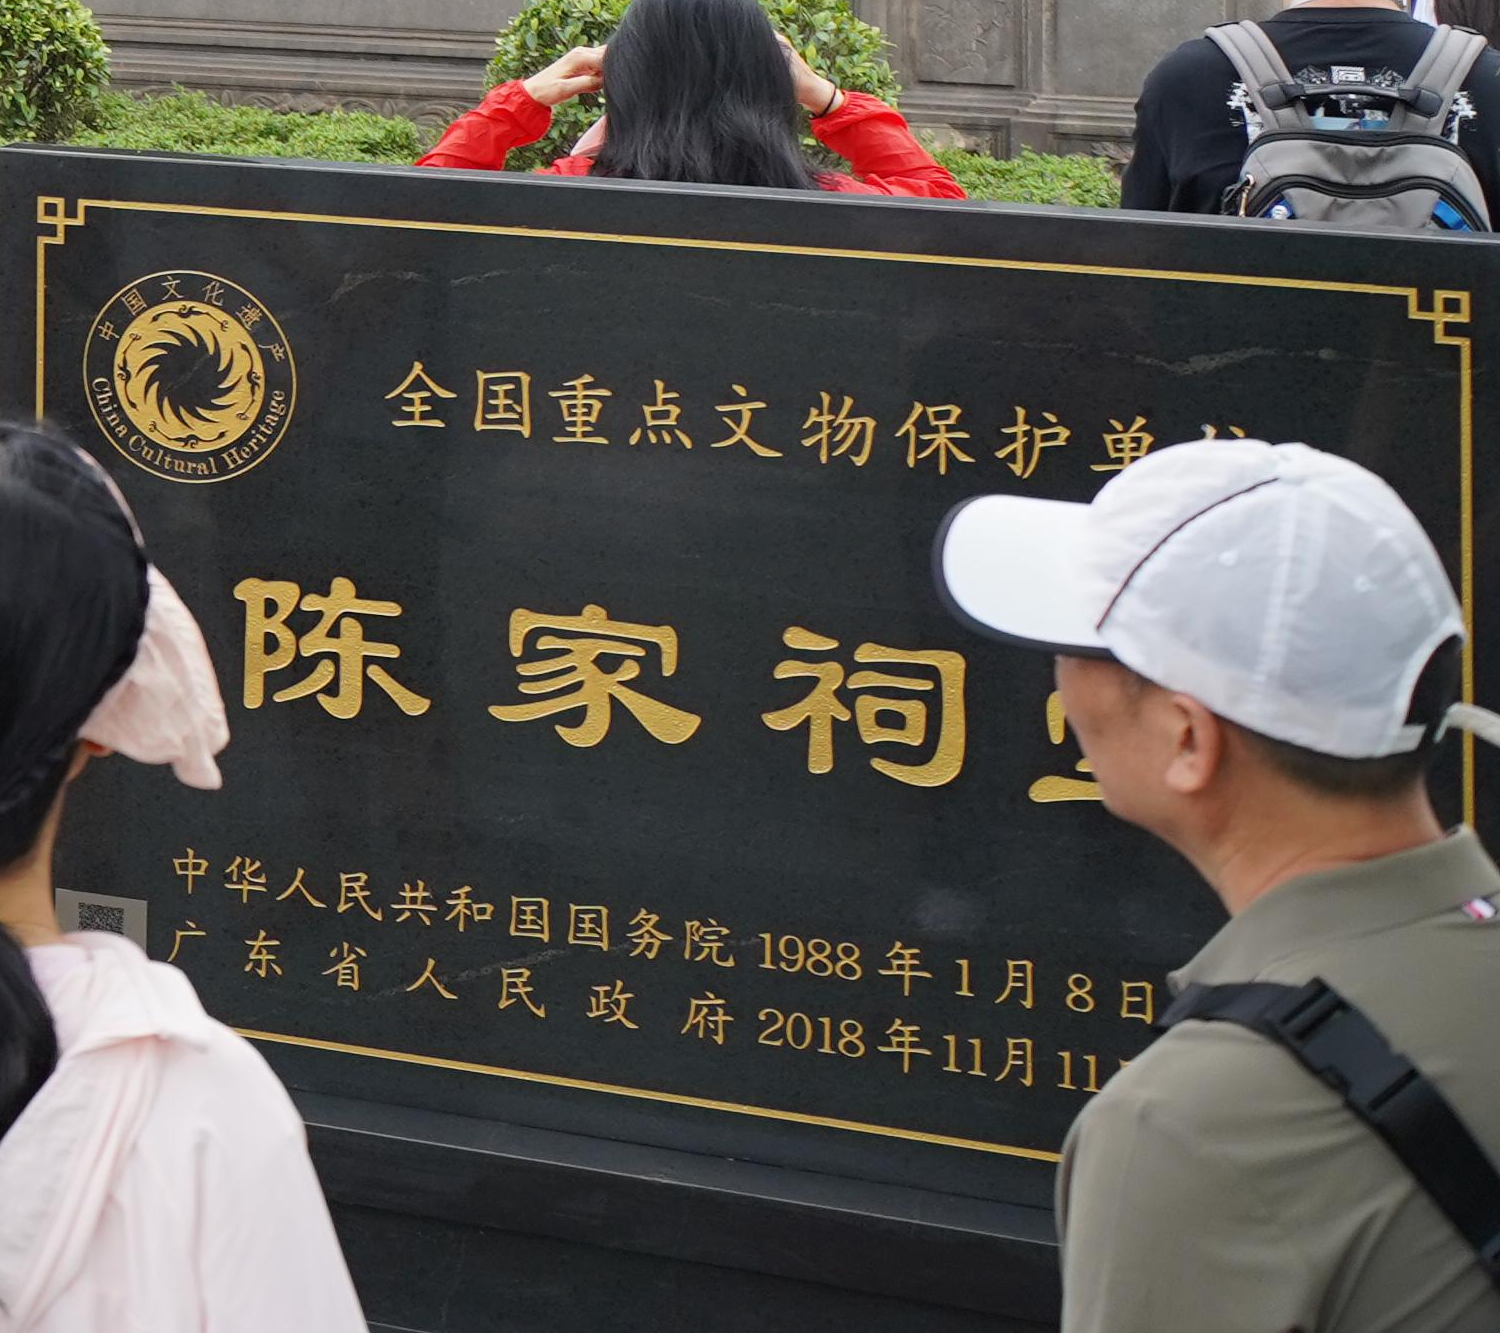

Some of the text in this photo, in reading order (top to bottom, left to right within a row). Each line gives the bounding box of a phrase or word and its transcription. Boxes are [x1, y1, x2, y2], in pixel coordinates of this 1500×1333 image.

[92, 377, 286, 475] China Cultural Heritage
[387, 360, 1246, 480] 全国重点文物保护单
[233, 577, 1105, 804] 陈家祠
[172, 846, 736, 968] 中华人民共和国国务院
[168, 920, 1129, 1093] 广东省人民政府 2018年11月11
